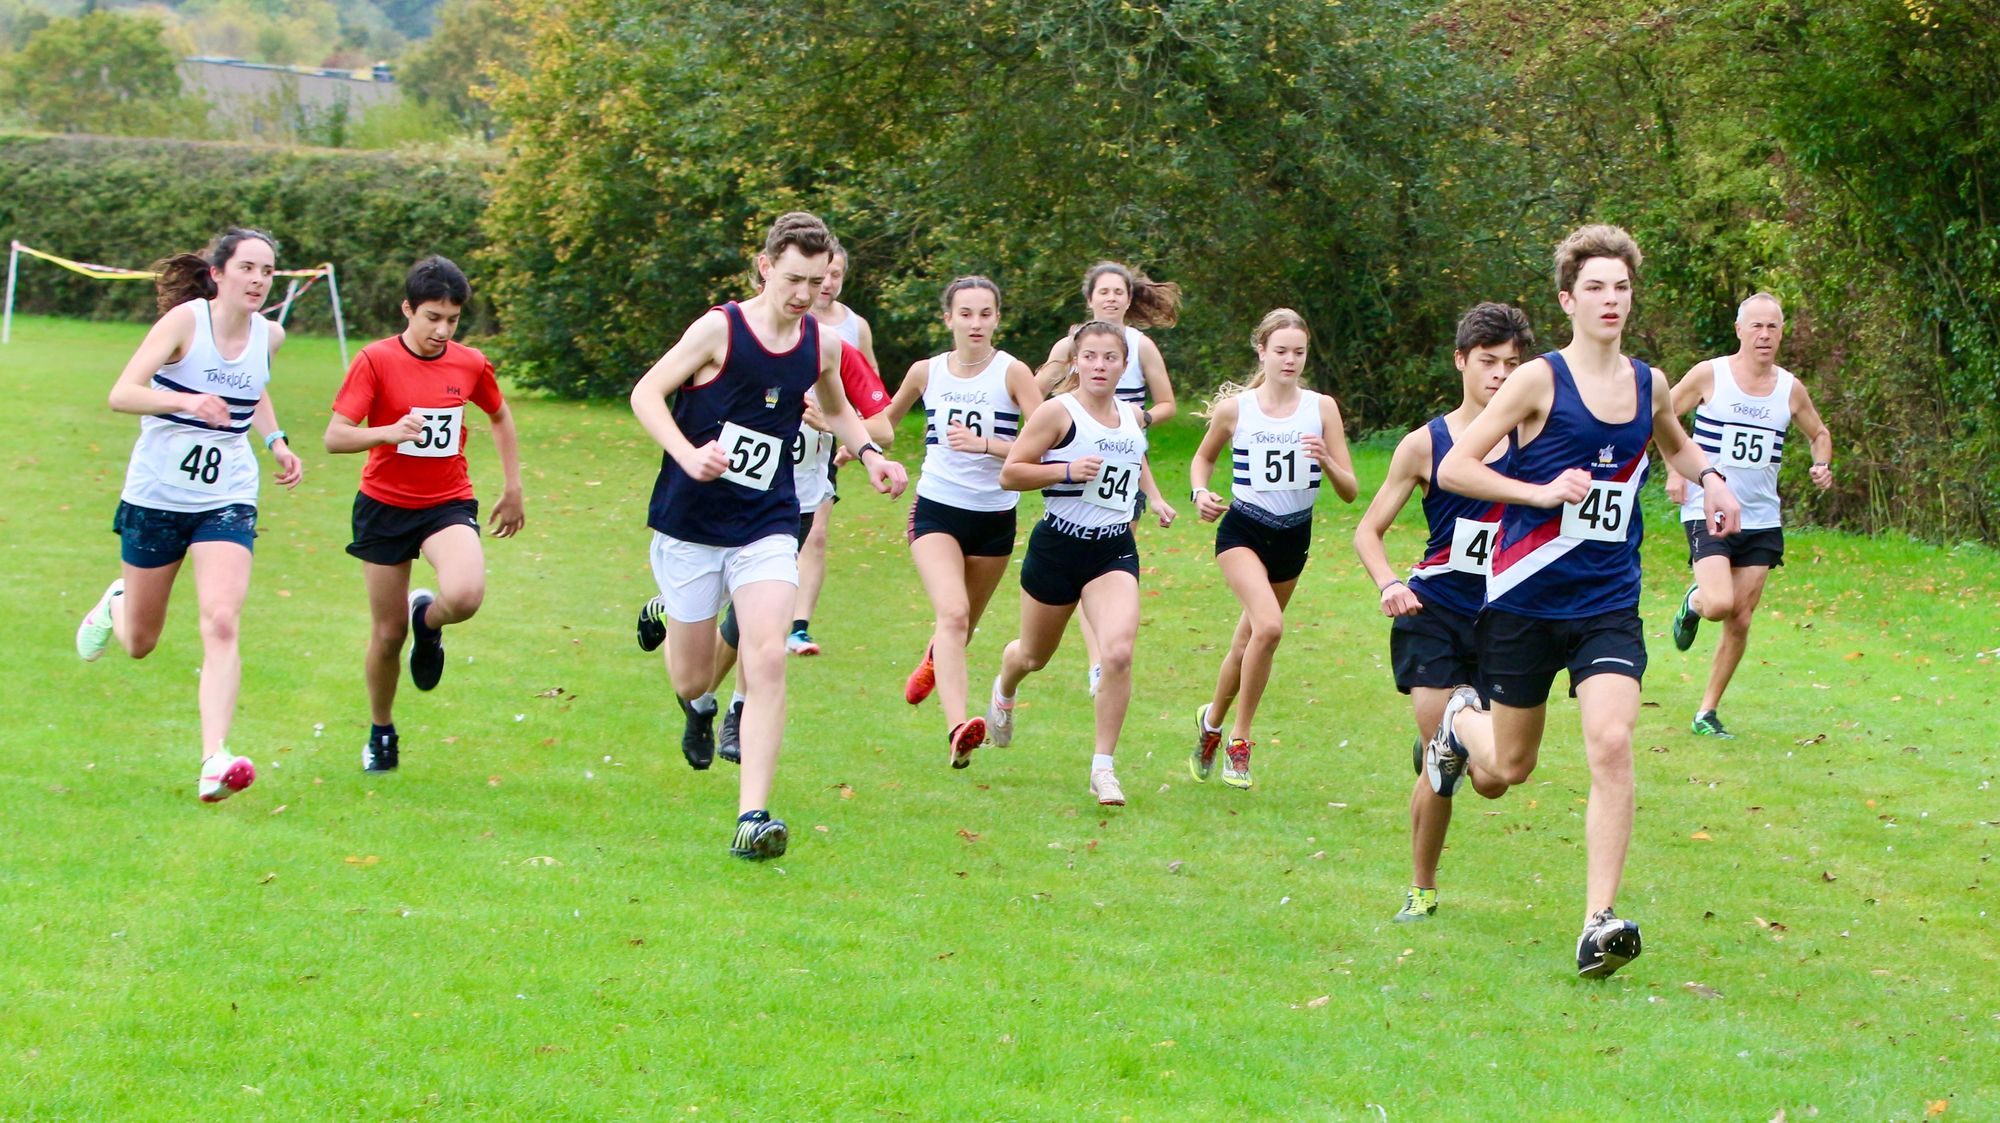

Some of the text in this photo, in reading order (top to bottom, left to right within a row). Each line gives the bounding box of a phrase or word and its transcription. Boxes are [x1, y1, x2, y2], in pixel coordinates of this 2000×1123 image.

[203, 368, 253, 389] TONBRIDGE
[447, 385, 460, 395] HH
[1094, 438, 1135, 454] TONBRIDGE
[1250, 430, 1303, 444] TONBRIDGE
[1732, 431, 1764, 463] 55
[180, 444, 222, 485] 48
[728, 434, 771, 480] 52
[1265, 450, 1295, 483] 51
[1098, 465, 1131, 502] 54
[1579, 488, 1622, 531] 45
[1051, 517, 1128, 540] NIKE PRO
[1466, 529, 1496, 566] 4
